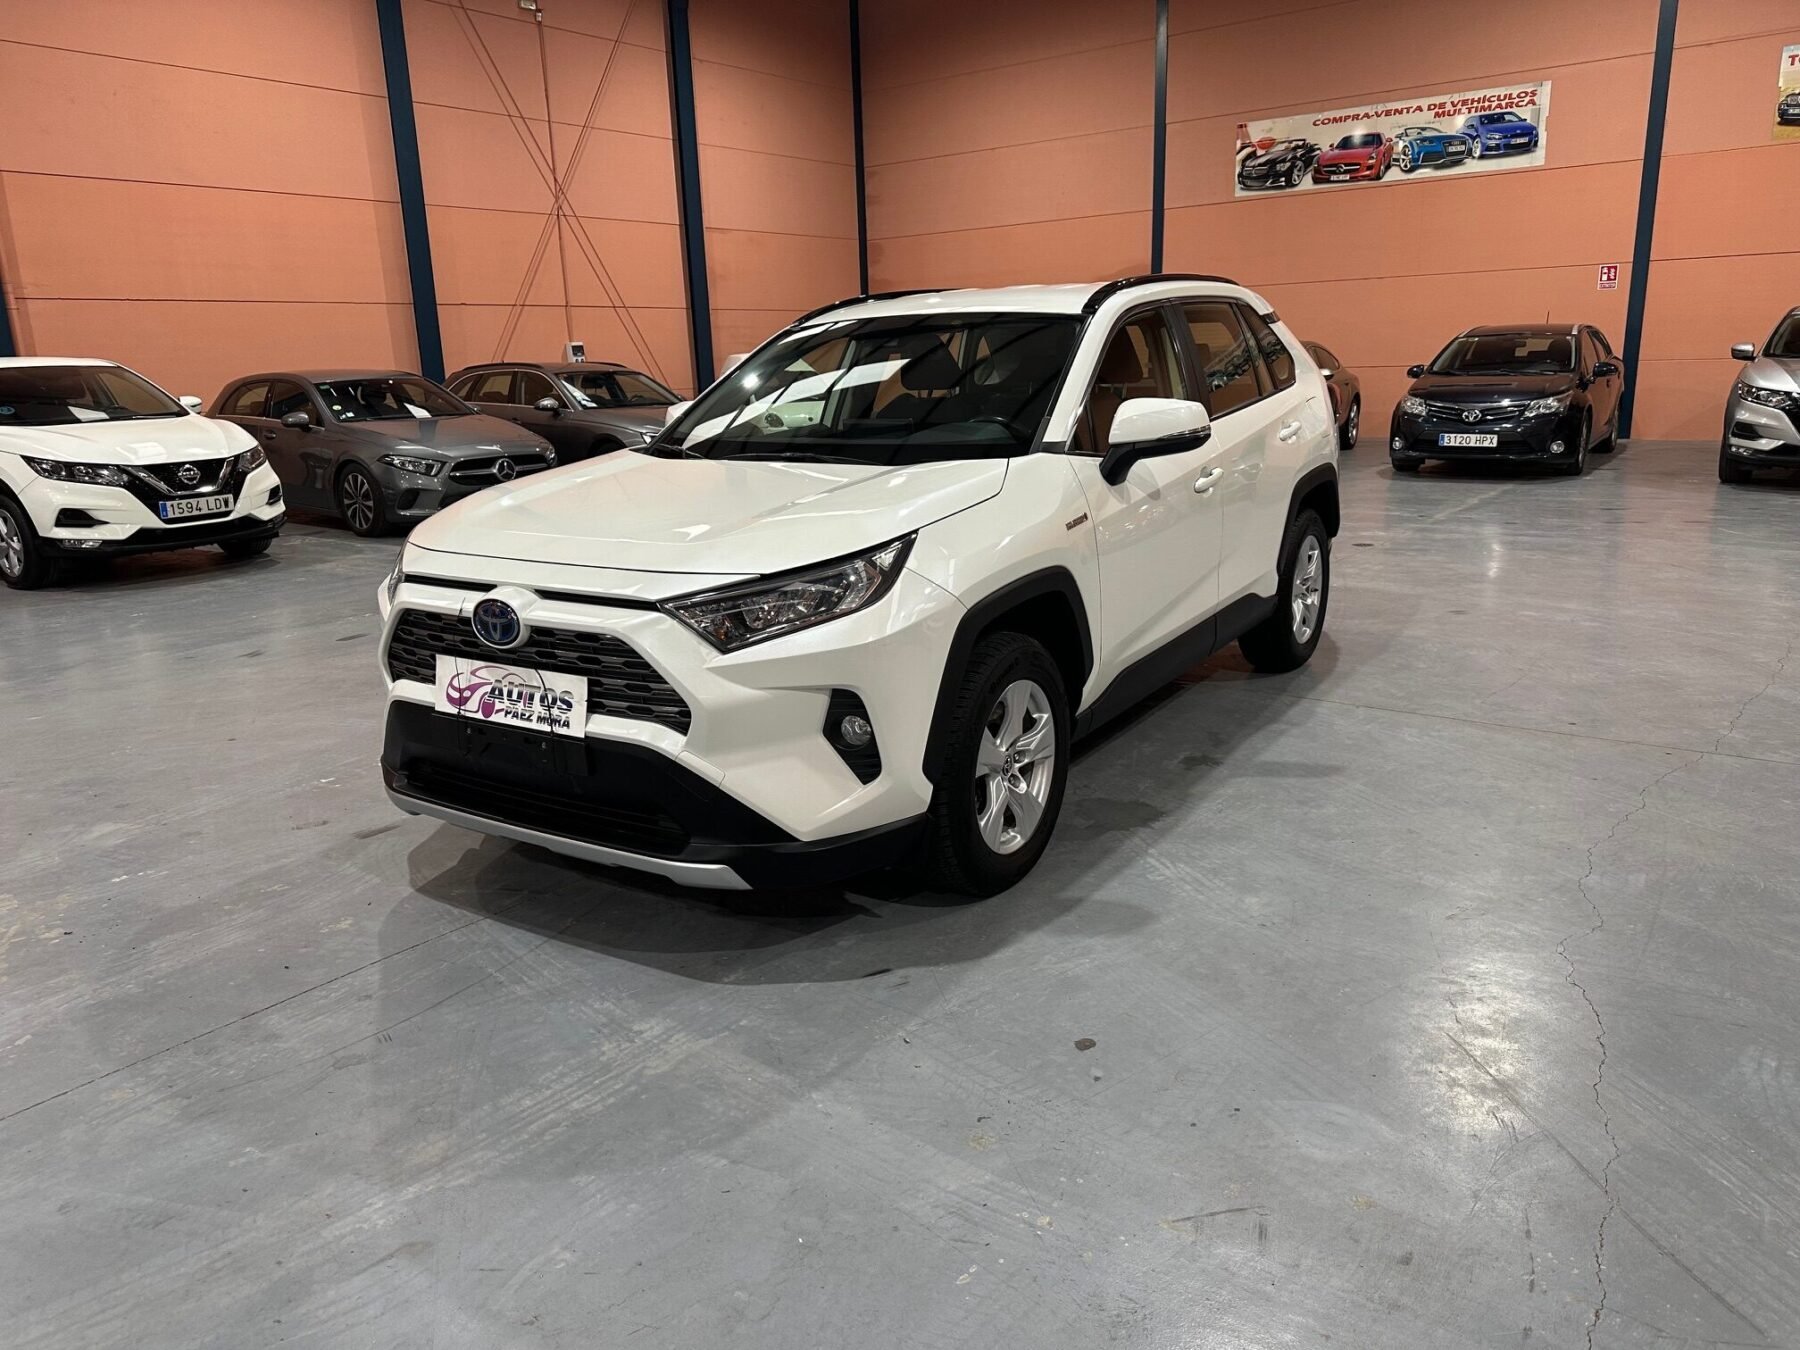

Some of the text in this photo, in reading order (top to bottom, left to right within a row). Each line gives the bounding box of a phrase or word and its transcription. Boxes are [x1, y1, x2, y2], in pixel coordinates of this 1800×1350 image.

[1312, 89, 1538, 127] COMPRA-VENTA DE VEHÍCULOS
[1433, 98, 1537, 119] MULTIMARCA
[1446, 434, 1494, 446] 3120 HPX
[169, 496, 231, 516] 1594 LDW
[487, 679, 575, 715] AUTOS
